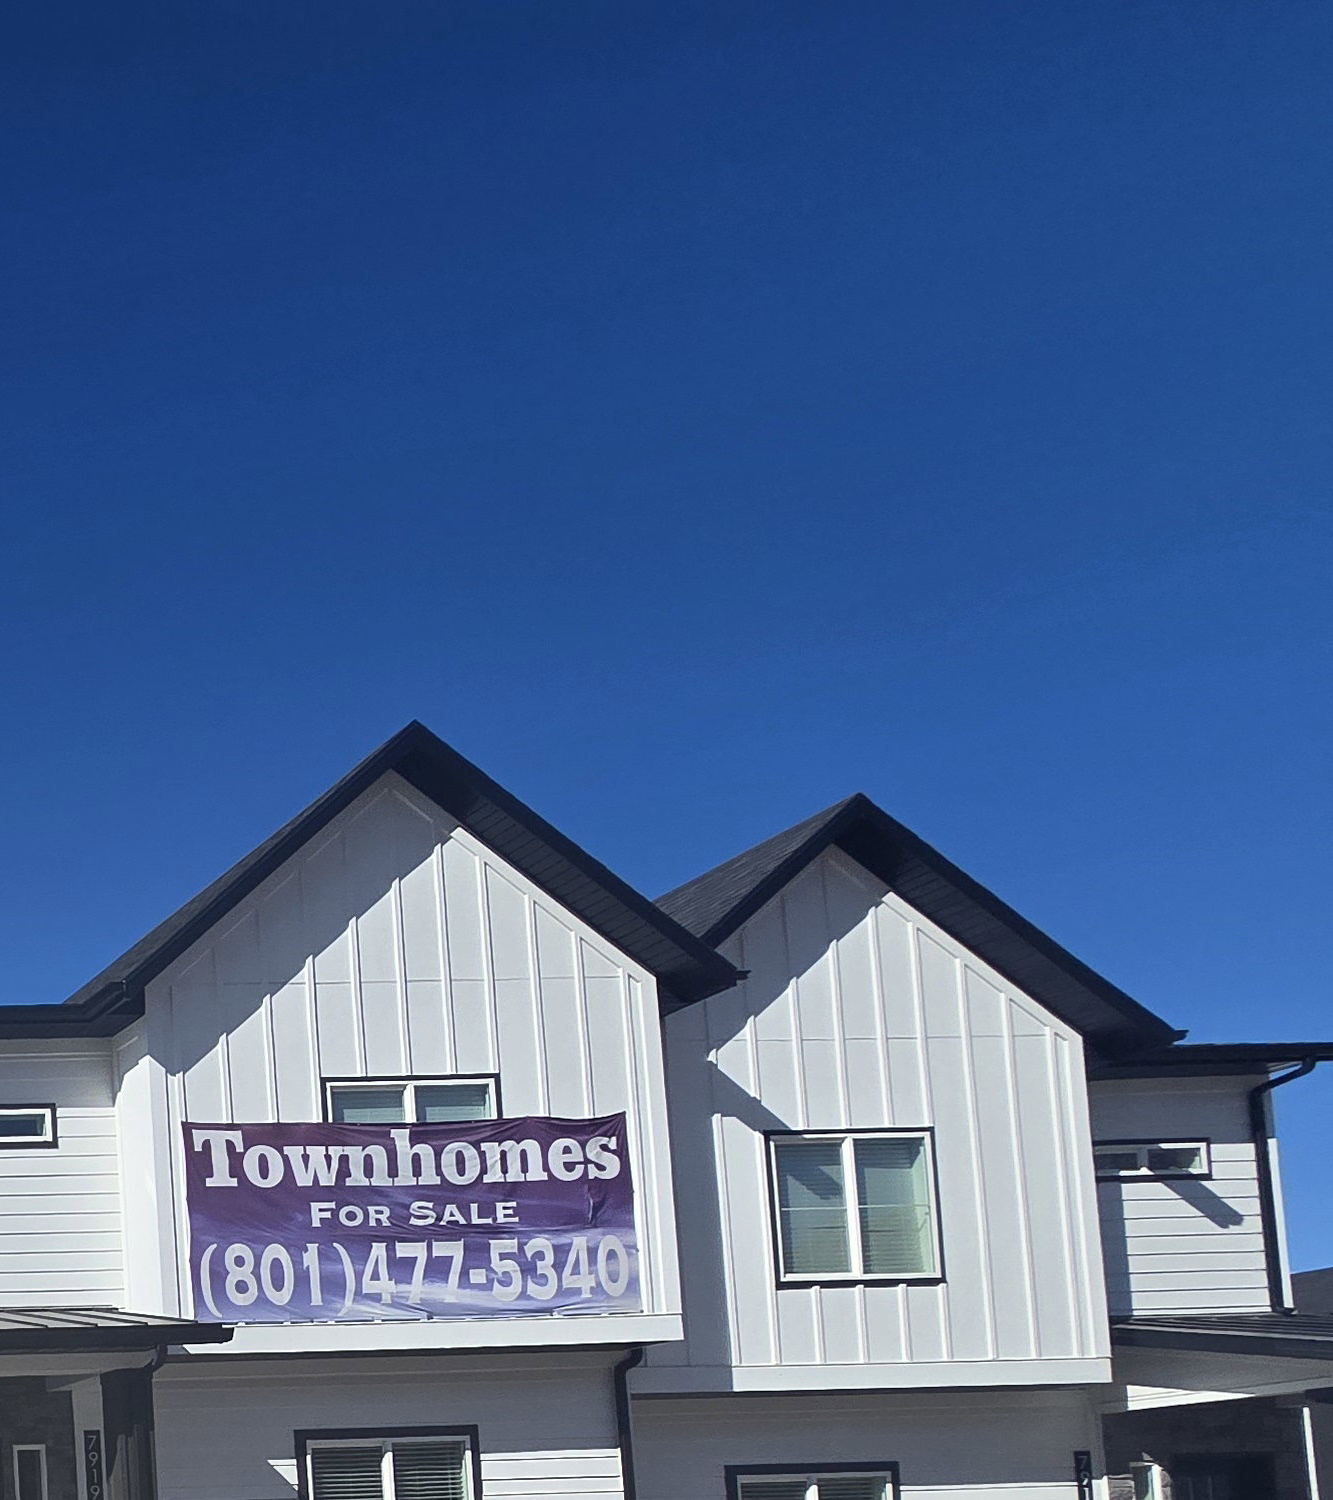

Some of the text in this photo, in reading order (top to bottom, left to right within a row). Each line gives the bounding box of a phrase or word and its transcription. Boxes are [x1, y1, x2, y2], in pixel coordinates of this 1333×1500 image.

[191, 1128, 623, 1188] Townhomes
[199, 1234, 630, 1318] (801)477-5340
[87, 1435, 100, 1500] 7919
